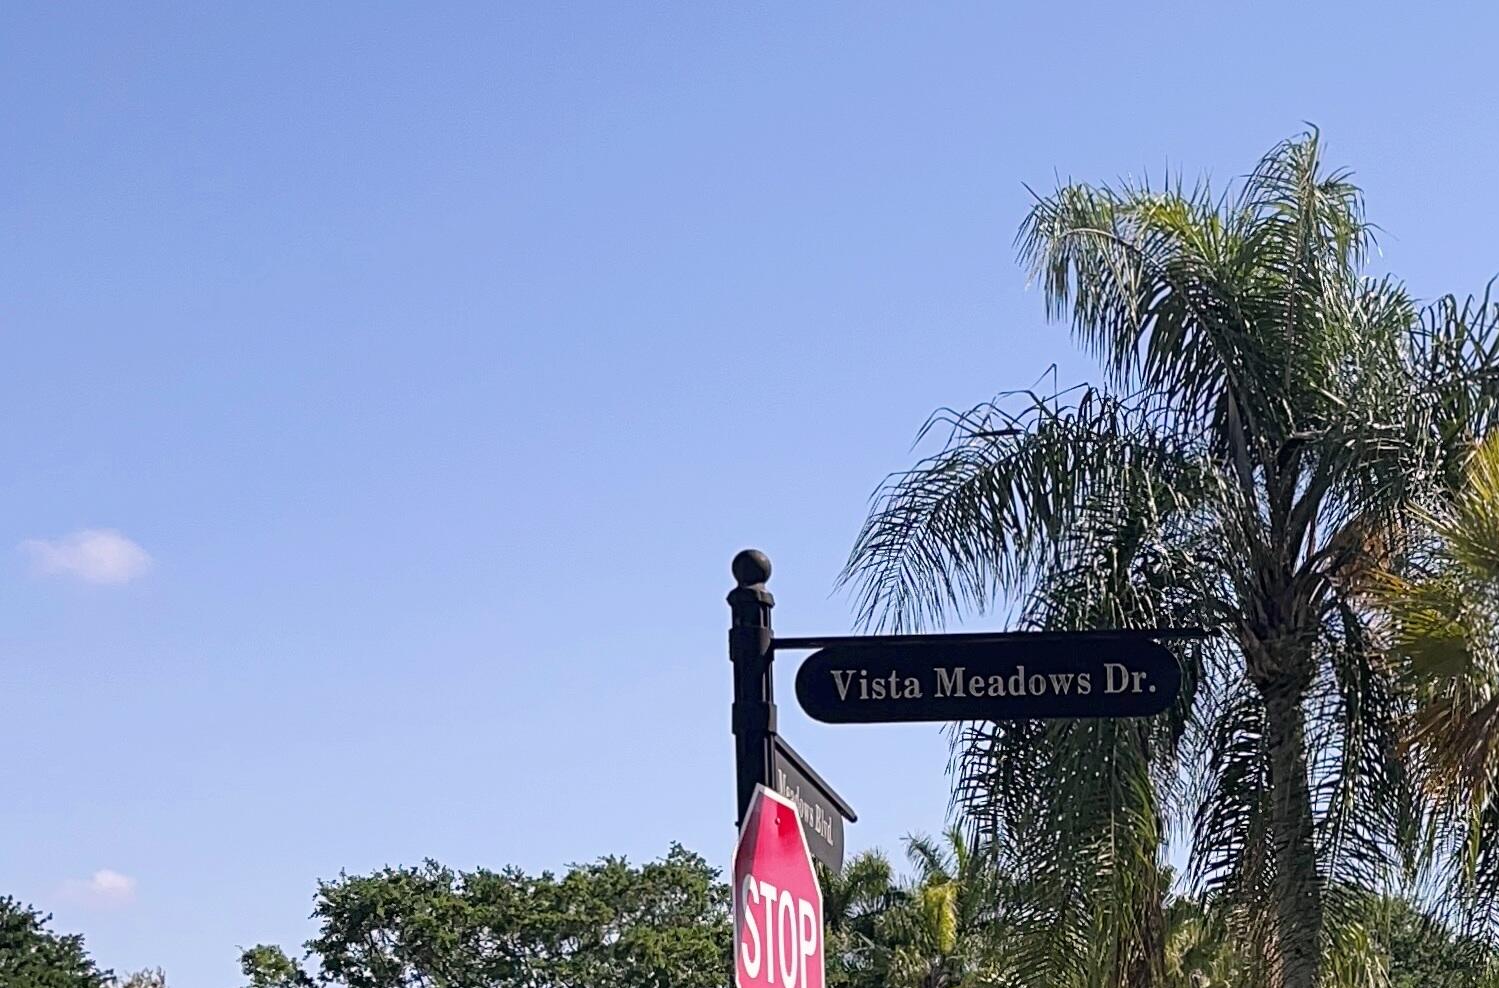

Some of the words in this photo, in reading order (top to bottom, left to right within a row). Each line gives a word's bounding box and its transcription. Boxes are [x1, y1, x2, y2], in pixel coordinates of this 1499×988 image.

[829, 668, 923, 701] Vista
[933, 665, 1092, 698] Meadows
[1103, 662, 1156, 693] Dr.
